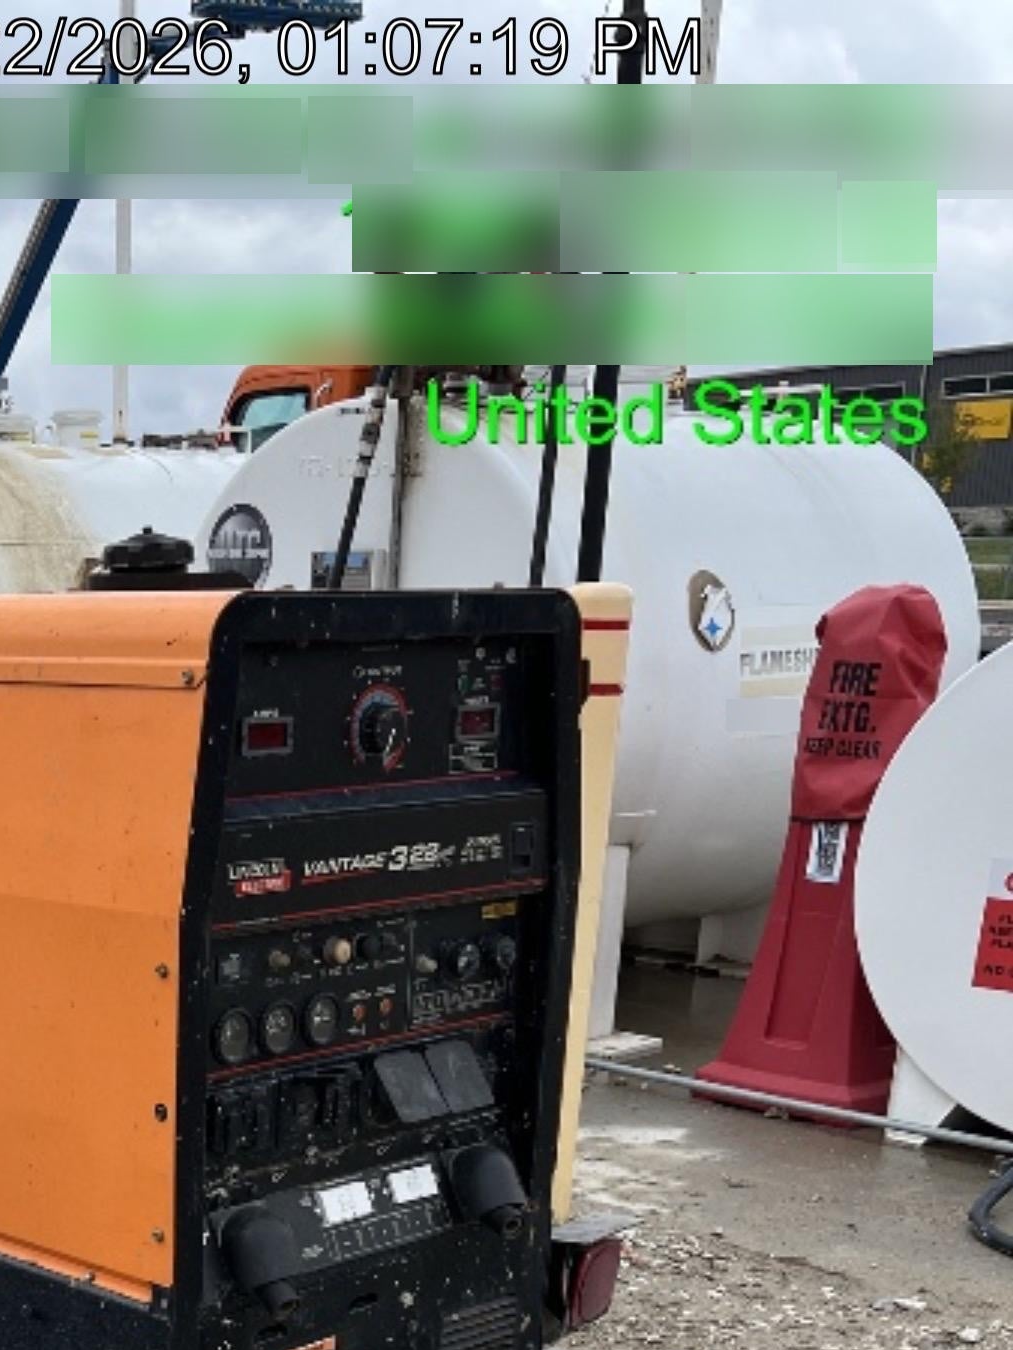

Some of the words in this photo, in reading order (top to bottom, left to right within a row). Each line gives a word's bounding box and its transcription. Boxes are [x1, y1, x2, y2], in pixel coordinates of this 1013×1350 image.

[740, 648, 821, 676] FLAMESH
[830, 660, 882, 696] FIRE
[303, 851, 388, 877] VANTAGE
